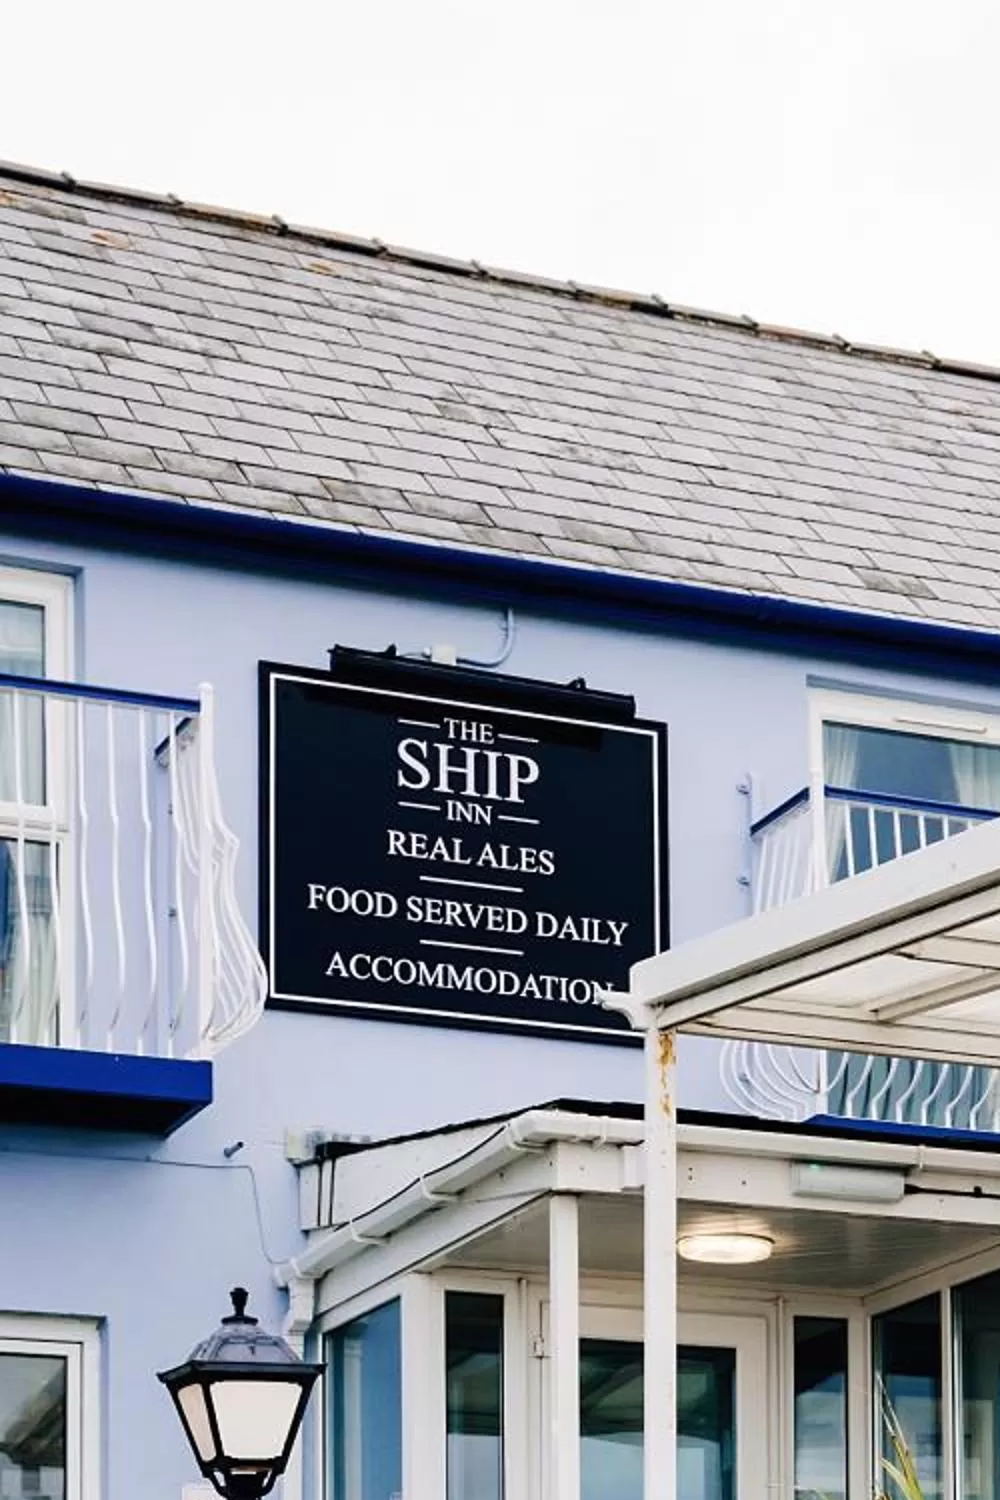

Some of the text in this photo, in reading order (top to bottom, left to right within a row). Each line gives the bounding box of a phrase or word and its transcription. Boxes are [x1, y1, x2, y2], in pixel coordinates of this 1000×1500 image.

[444, 718, 494, 744] THE
[398, 738, 540, 803] SHIP
[447, 800, 493, 825] INN
[387, 830, 555, 875] REAL ALES
[308, 884, 629, 945] FOOD SERVED DAILY
